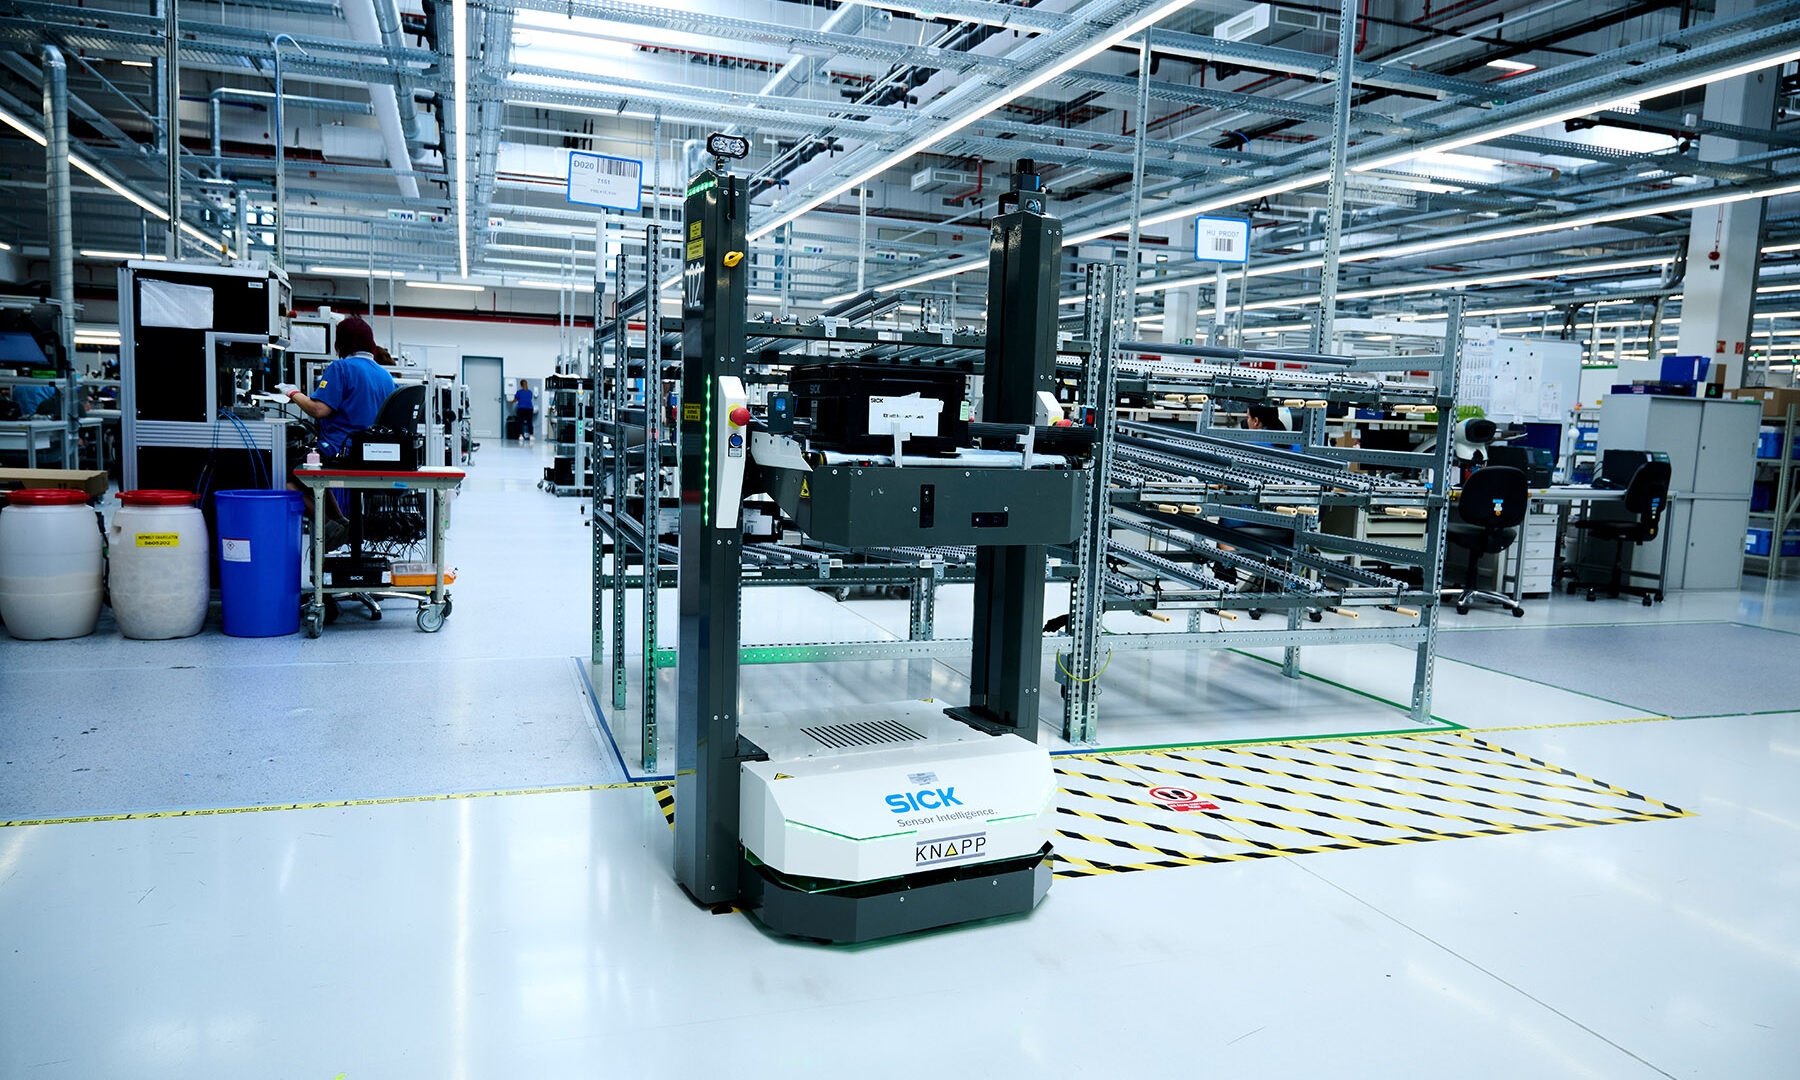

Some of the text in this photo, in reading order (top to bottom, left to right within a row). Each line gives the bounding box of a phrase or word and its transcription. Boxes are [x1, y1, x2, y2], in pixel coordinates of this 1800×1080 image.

[885, 787, 963, 813] SICK
[896, 808, 998, 827] Sensor Intelligence.
